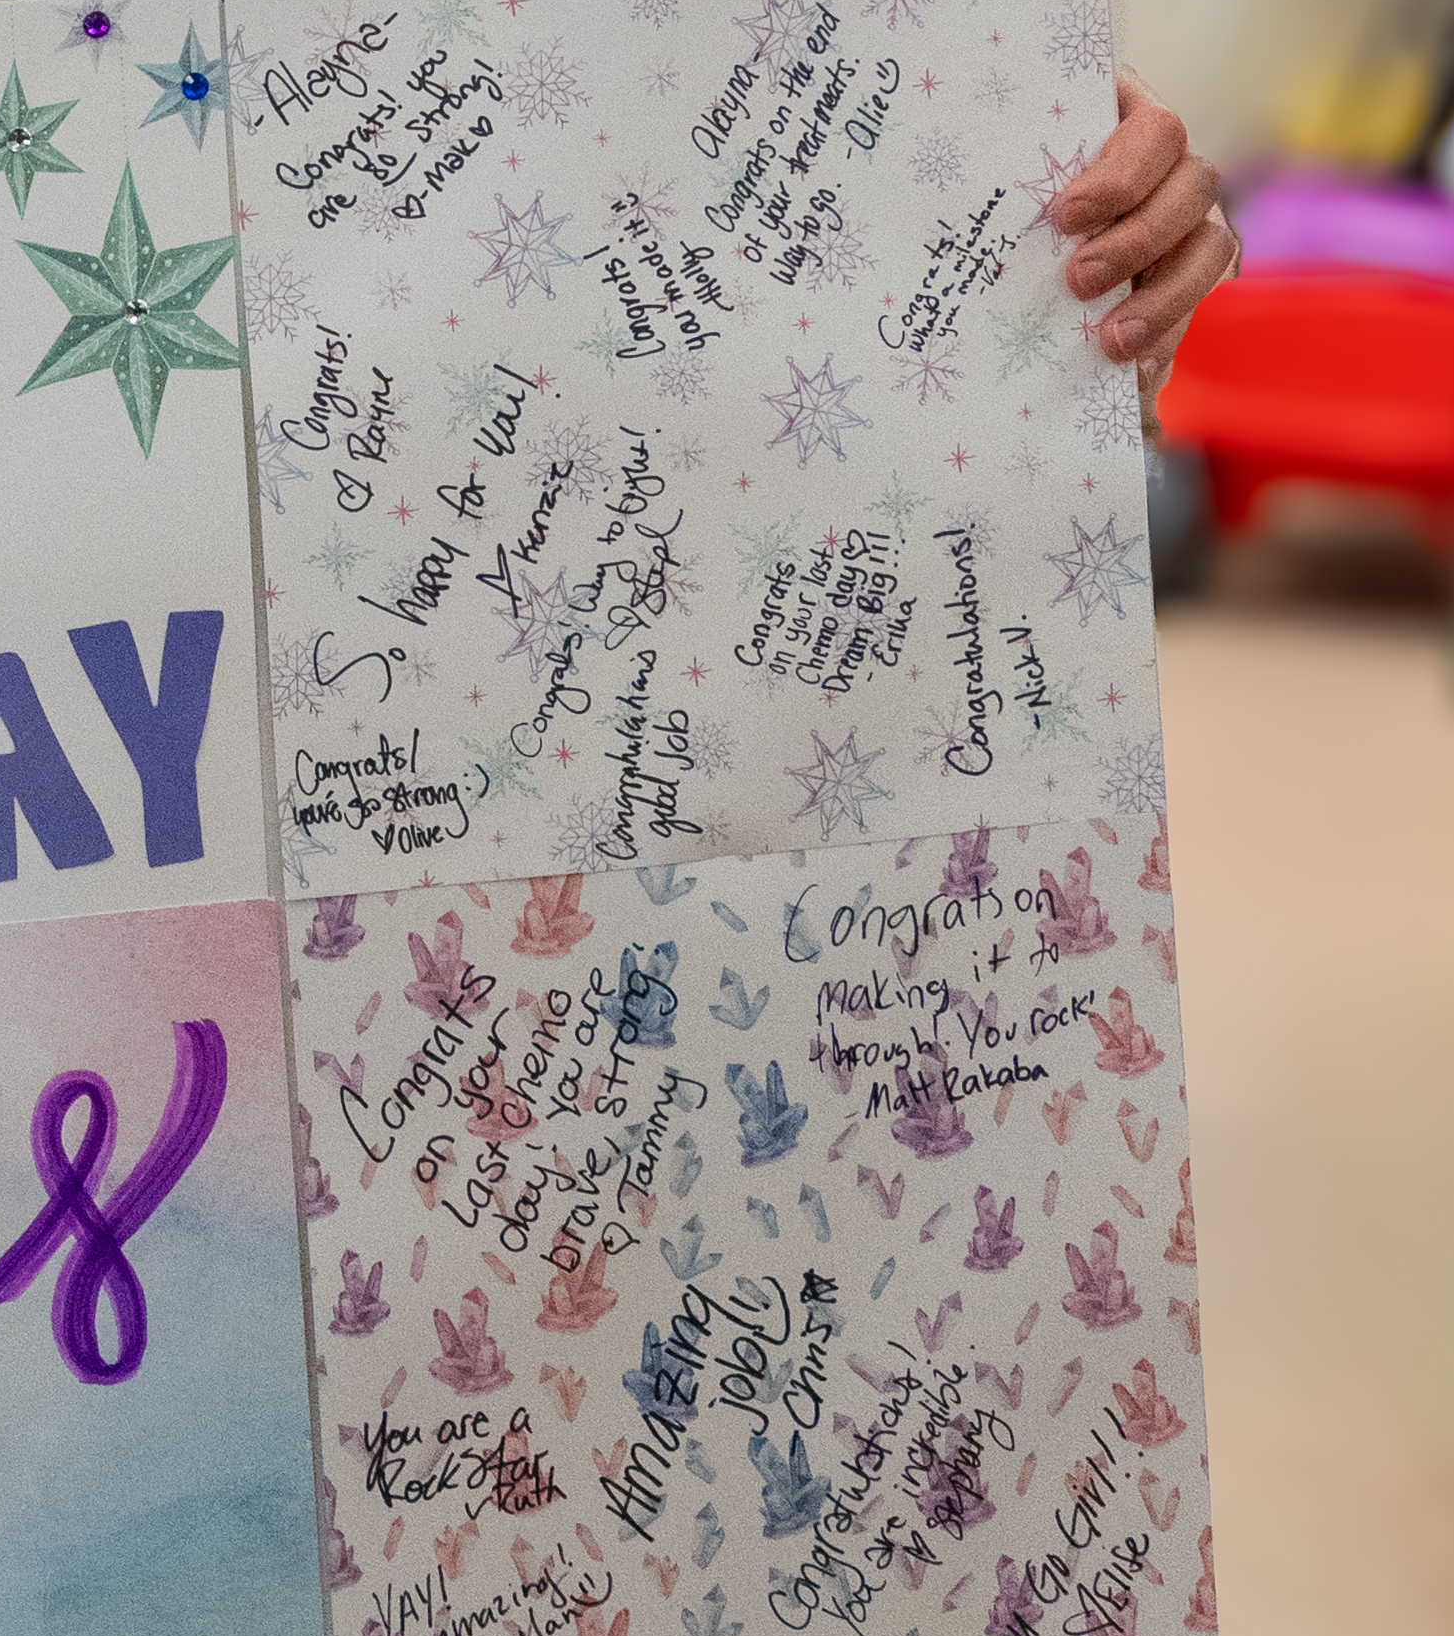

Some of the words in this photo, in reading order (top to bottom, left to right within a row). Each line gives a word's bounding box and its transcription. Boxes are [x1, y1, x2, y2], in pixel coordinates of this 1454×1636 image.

[807, 3, 841, 55] end
[780, 60, 814, 98] the
[277, 89, 401, 189] Congrats!
[769, 105, 792, 136] on
[308, 193, 357, 229] are
[705, 138, 776, 232] Congrats
[743, 234, 764, 262] of
[759, 181, 792, 240] your
[769, 243, 823, 286] Way
[792, 212, 821, 247] to
[637, 240, 684, 304] made
[878, 220, 962, 349] Congrats!
[279, 324, 353, 451] Congrats!
[358, 537, 470, 625] happy
[735, 561, 796, 666] Congrats
[769, 651, 796, 675] on
[788, 591, 815, 645] your
[802, 548, 833, 595] last
[796, 616, 839, 684] Chemo
[837, 567, 868, 607] day
[822, 629, 872, 692] Dream
[933, 522, 1003, 775] Congratulations!
[314, 632, 406, 702] So
[510, 621, 591, 757] Congrats!
[296, 727, 420, 795] Congrats!
[786, 877, 1003, 963] Congrats
[1015, 887, 1057, 920] on
[575, 968, 615, 1046] are
[817, 971, 950, 1026] making
[972, 944, 1012, 981] it
[1030, 934, 1059, 976] to
[340, 964, 495, 1163] Congrats
[957, 1007, 1017, 1059] You
[416, 1134, 454, 1184] on
[454, 1007, 509, 1119] your
[866, 1071, 940, 1119] Matt
[437, 1411, 490, 1445] are
[510, 1407, 532, 1434] a
[493, 1465, 567, 1514] Ruth
[866, 1515, 906, 1568] are
[1025, 1552, 1069, 1604] Go
